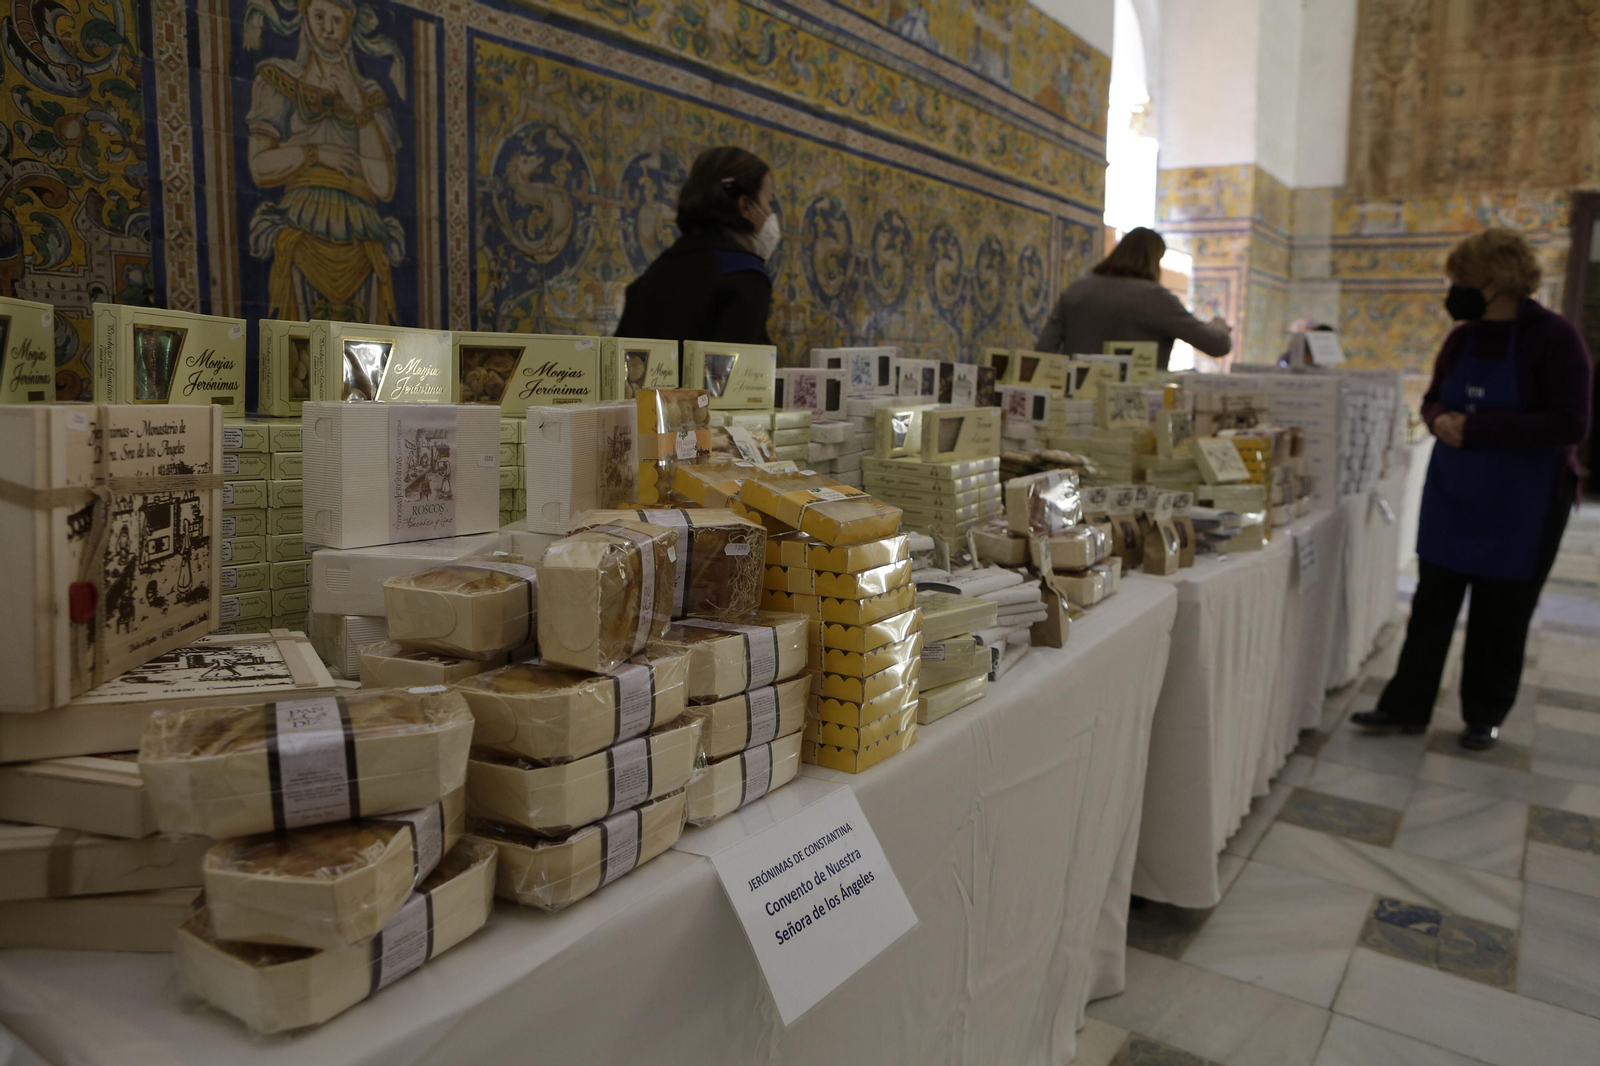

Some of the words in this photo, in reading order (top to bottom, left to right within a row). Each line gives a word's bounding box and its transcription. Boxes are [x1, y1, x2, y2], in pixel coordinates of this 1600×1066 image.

[11, 338, 48, 368] Monjas
[186, 349, 235, 375] Monjas
[10, 362, 51, 392] Jerónimas
[394, 358, 441, 381] Monjas
[523, 361, 585, 383] Monjas
[183, 370, 240, 397] Jerónimas
[518, 379, 591, 400] Jerónimas
[136, 420, 178, 438] Monasterio
[179, 419, 186, 434] de
[137, 443, 145, 458] de
[146, 442, 156, 458] los
[412, 502, 445, 516] ROSCOS
[748, 858, 794, 892] JERÓNIMAS
[793, 851, 805, 865] DE
[803, 822, 853, 857] CONSTANTINA
[765, 880, 814, 917] Convento
[814, 871, 827, 888] de
[825, 849, 862, 878] Nuestra
[775, 914, 813, 946] Señora
[812, 903, 826, 920] de
[824, 895, 841, 911] los
[840, 870, 875, 901] Ángeles
